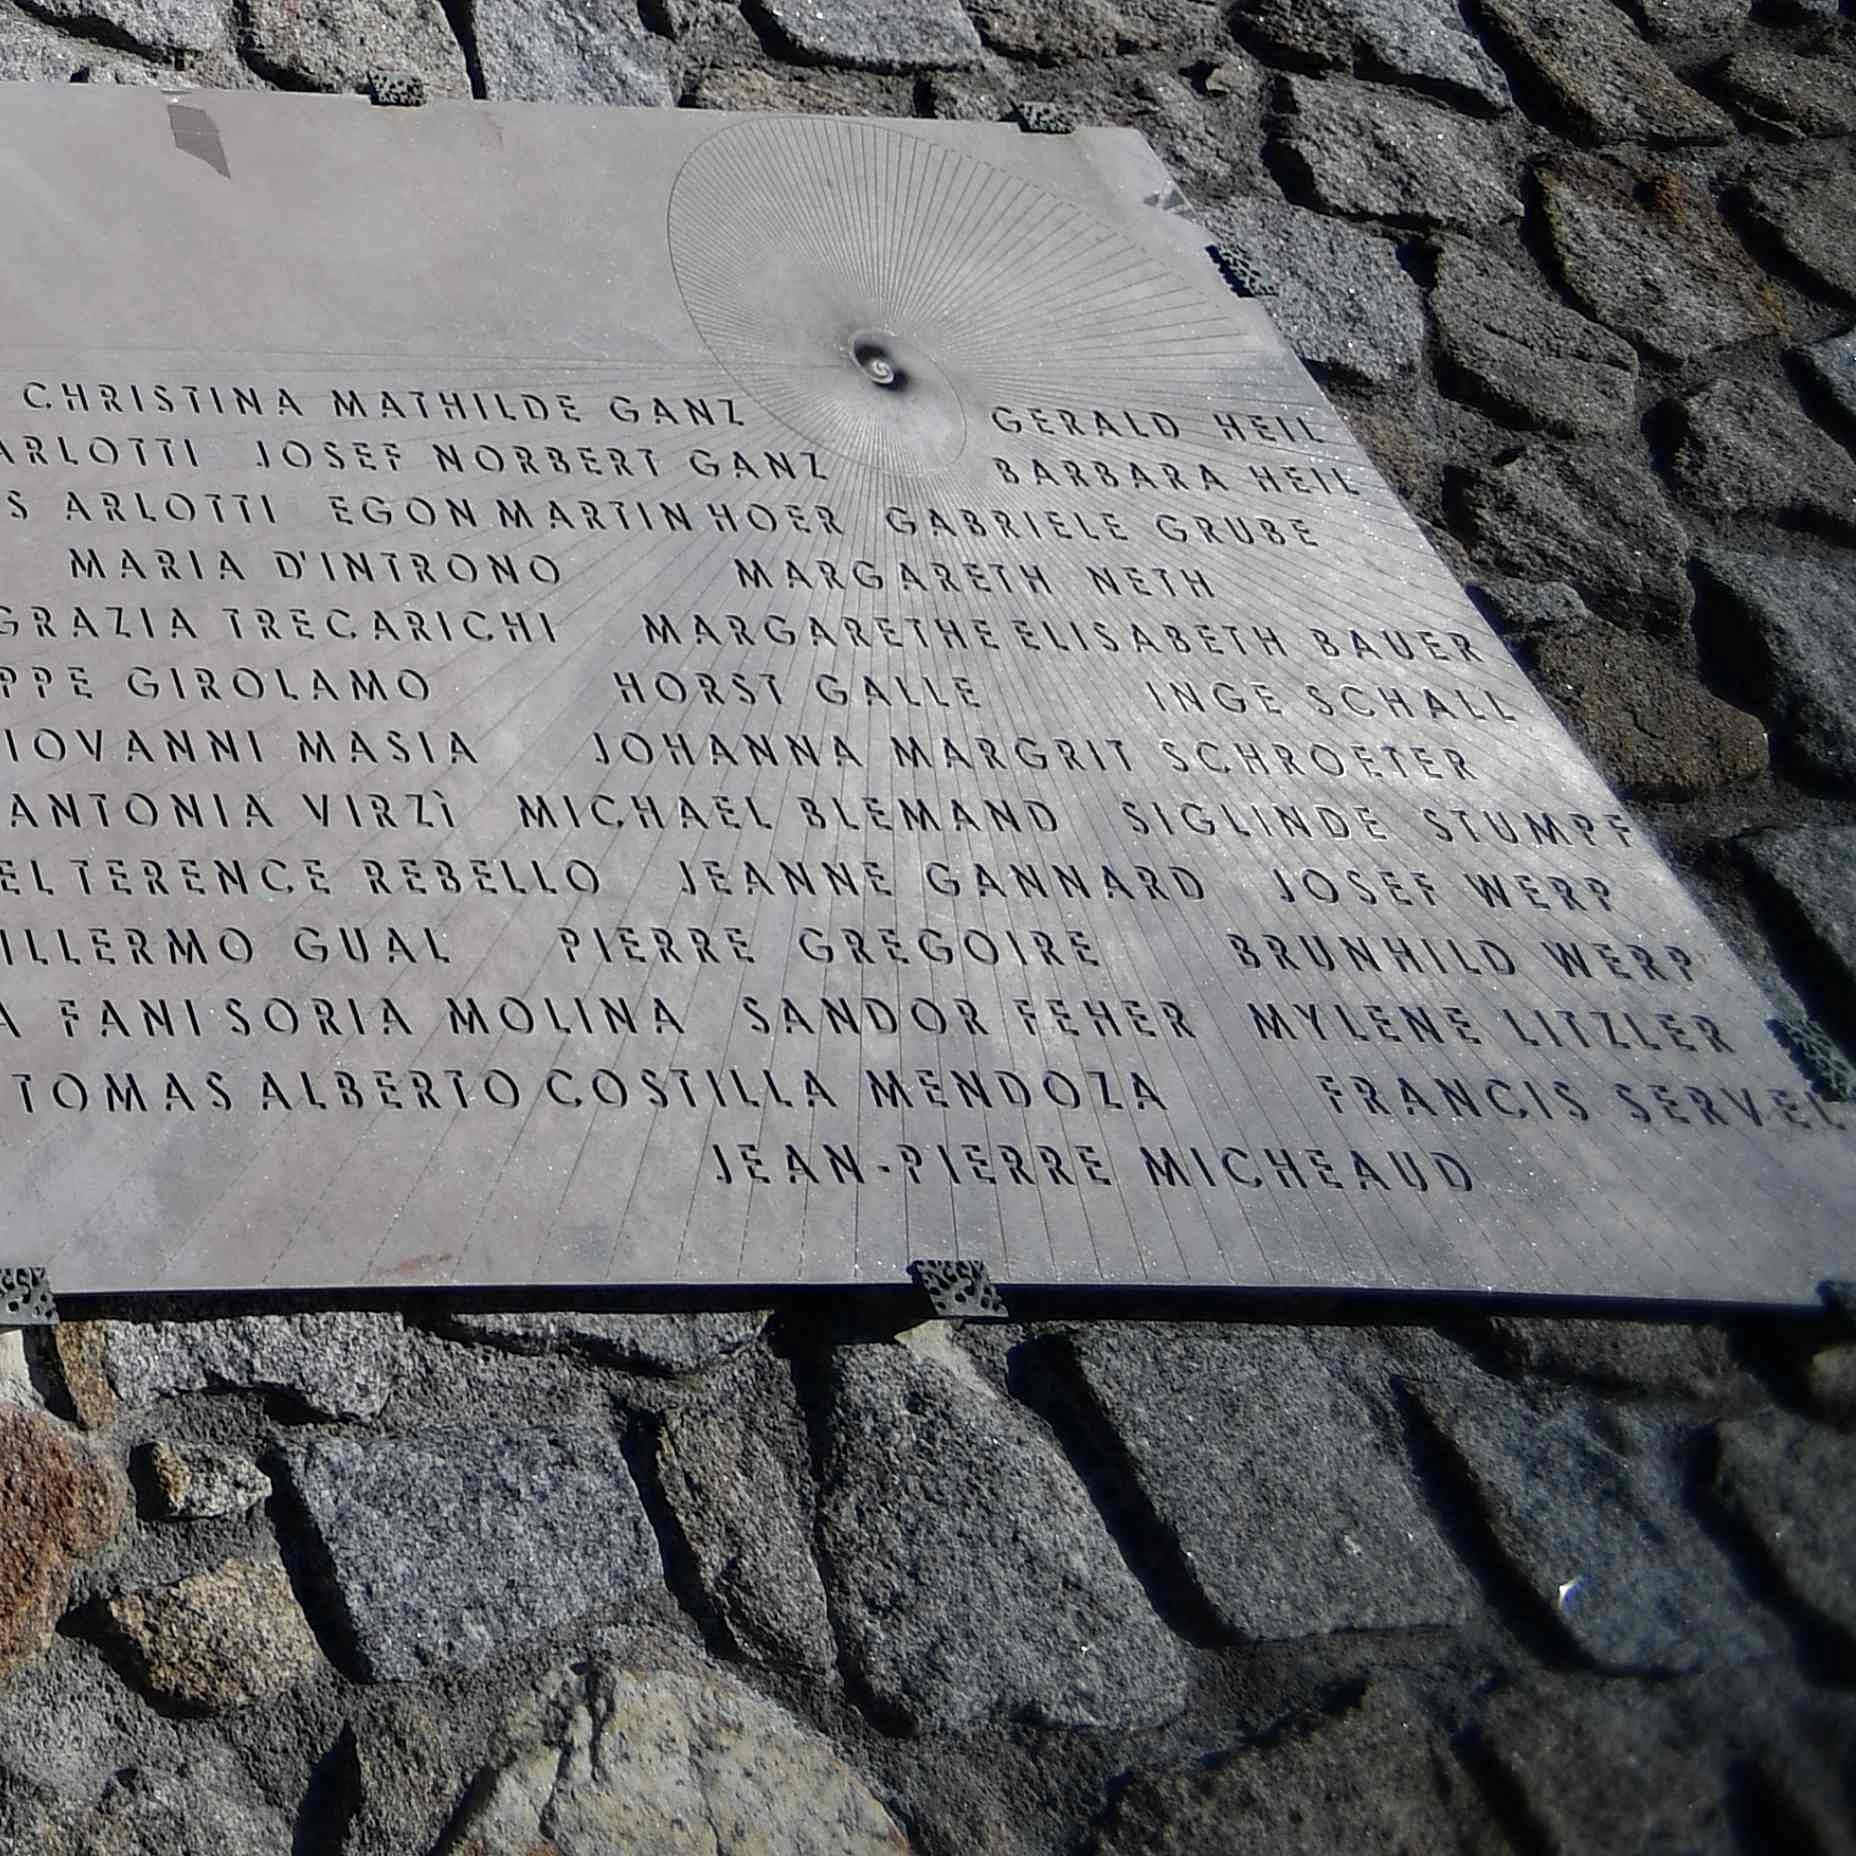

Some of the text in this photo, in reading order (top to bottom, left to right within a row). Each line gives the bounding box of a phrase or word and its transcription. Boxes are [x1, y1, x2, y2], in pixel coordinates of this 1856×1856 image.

[23, 382, 745, 426] CHRISTINA MATHILDE GANZ
[992, 406, 1325, 443] GERALD HEIL
[254, 440, 830, 480] JOSEF NORBERT GANZ
[996, 458, 1360, 497] BARBARA HEIL
[65, 490, 277, 525] ARLOTTI
[332, 495, 844, 535] EGON MARTIN HOER
[886, 506, 1320, 548] GABRIELE GRUBE
[69, 549, 561, 584] MARIA D'INTRONO
[737, 558, 1216, 599] MARGARETH NETH
[222, 607, 556, 644] TRECARICHI
[1318, 629, 1483, 664] BAUER
[126, 667, 432, 703] GIROLAMO
[615, 672, 982, 710] HORST GALLE
[1146, 679, 1517, 724] INGE SCHALL
[298, 729, 477, 766] MASIA
[593, 731, 1478, 781] JOHANNA MARGRIT SCHROETER
[8, 792, 275, 829] ANTONIA
[517, 794, 1060, 834] MICHAEL BLEMAND
[1122, 800, 1640, 849] SIGLINDE STUMPF
[72, 859, 333, 897] TERENCE
[364, 859, 602, 897] REBELLO
[680, 860, 1205, 901] JEANNE GANNARD
[1277, 869, 1614, 914] JOSEF WERP
[293, 927, 451, 966] GUAL
[560, 926, 1102, 968] PIERRE GREGOIRE
[1226, 932, 1695, 983] BRUNHILD WERP
[447, 997, 685, 1034] MOLINA
[742, 996, 1196, 1040] SANDOR FEHER
[1250, 1003, 1736, 1055] MYLENE LITZLER
[12, 1069, 1167, 1113] TOMAS ALBERTO COSTILLA MENDOZA
[1320, 1074, 1590, 1122] FRANCIS
[1144, 1146, 1475, 1194] MICHEAUD
